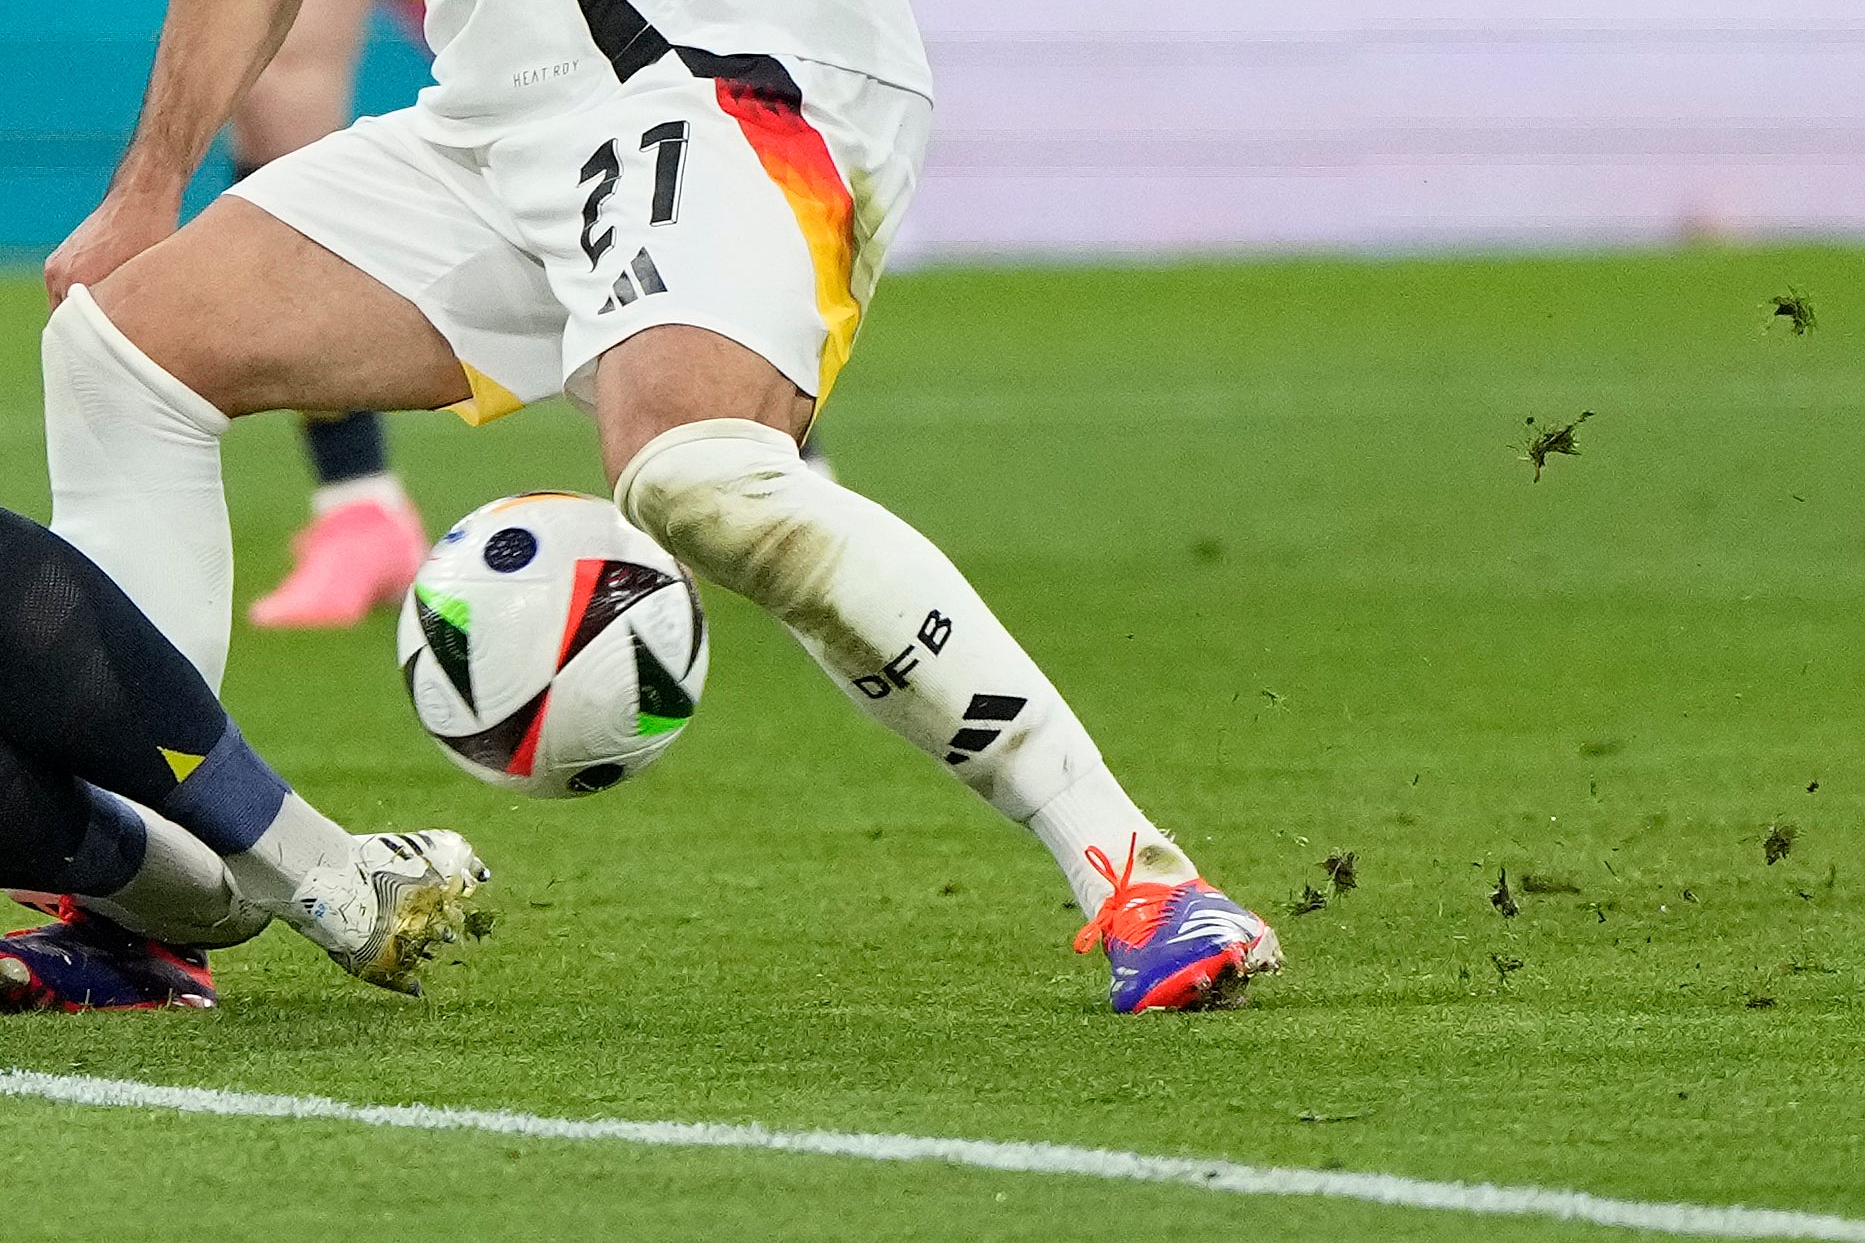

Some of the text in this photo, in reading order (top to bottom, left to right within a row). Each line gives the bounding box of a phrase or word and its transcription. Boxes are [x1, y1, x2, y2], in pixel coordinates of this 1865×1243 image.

[512, 66, 548, 88] HEAT
[576, 120, 691, 274] 21
[852, 608, 953, 700] DFB
